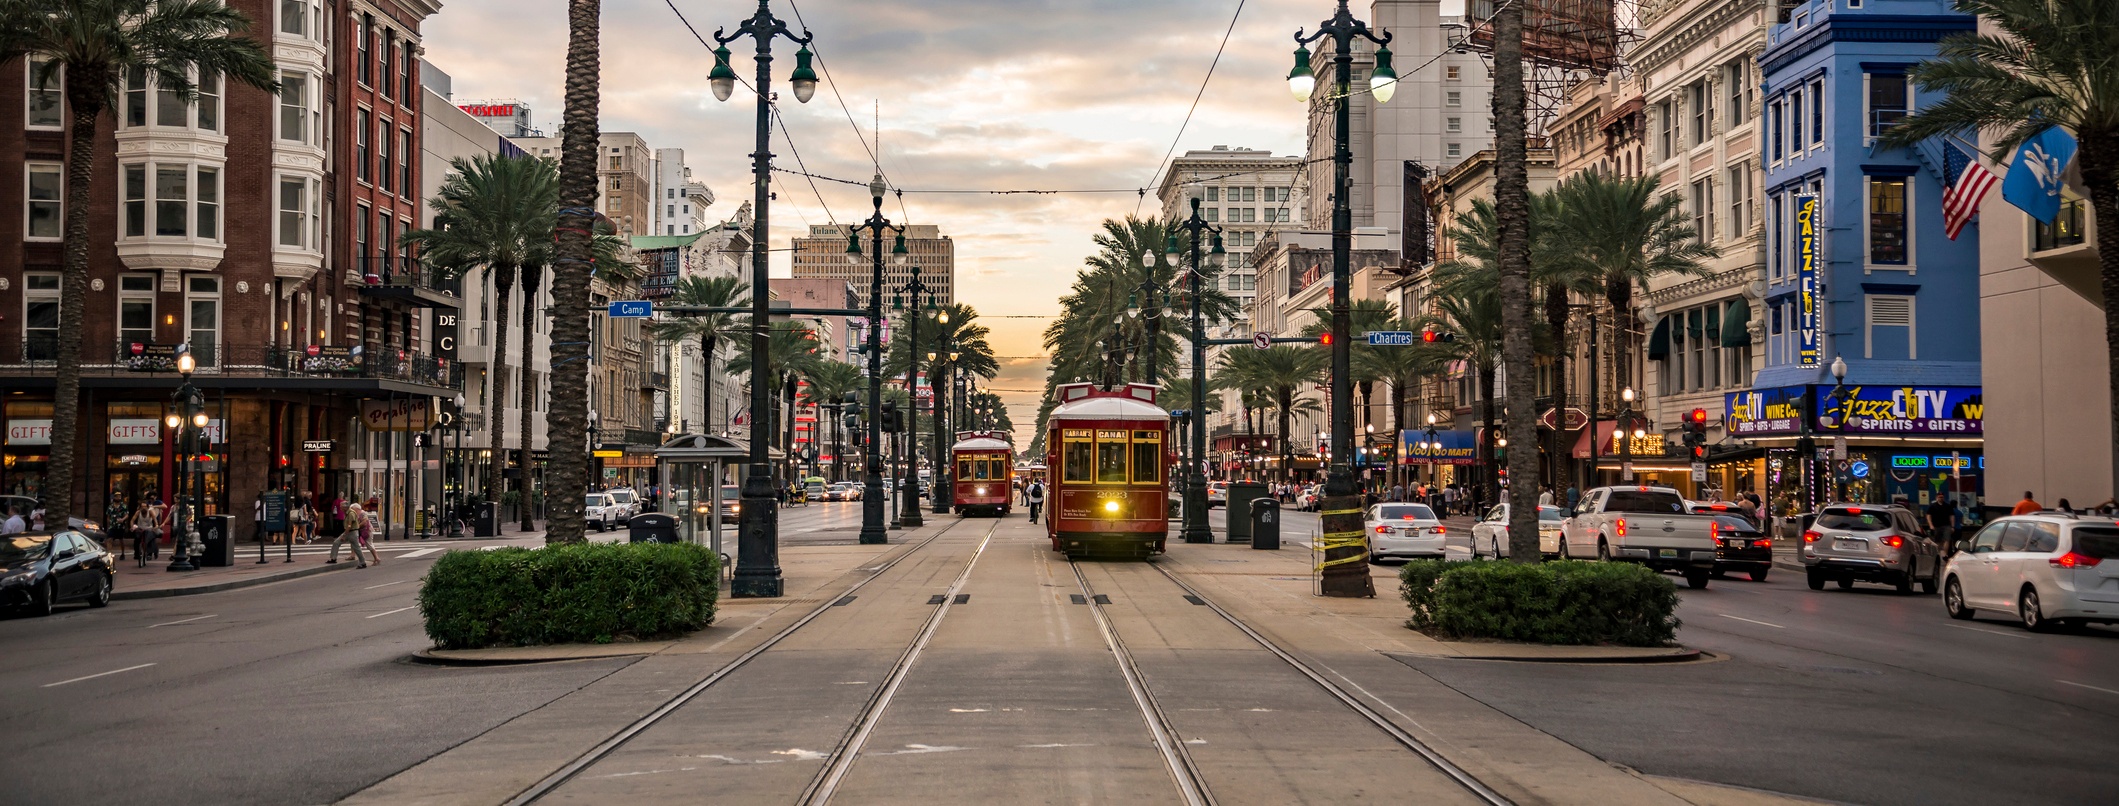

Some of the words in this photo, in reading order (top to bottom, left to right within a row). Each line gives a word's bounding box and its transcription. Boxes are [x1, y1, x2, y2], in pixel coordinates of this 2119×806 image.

[811, 226, 838, 235] Tulane
[1798, 200, 1816, 271] JAZZ
[621, 303, 644, 316] Camp
[439, 315, 456, 326] DE
[1374, 332, 1411, 344] Chartres
[369, 400, 425, 424] Praline
[1766, 404, 1785, 420] WINE
[1739, 422, 1754, 432] SPIRITS
[1757, 420, 1768, 431] GIFTS
[1771, 420, 1790, 430] LUGGAGE
[1861, 419, 1913, 431] SPIRITS
[1928, 420, 1966, 431] GIFTS
[112, 426, 156, 438] GIFTS
[1447, 448, 1473, 456] MART
[1895, 457, 1926, 466] LIQUOR
[1935, 458, 1953, 466] COLD
[1096, 491, 1128, 499] 2023
